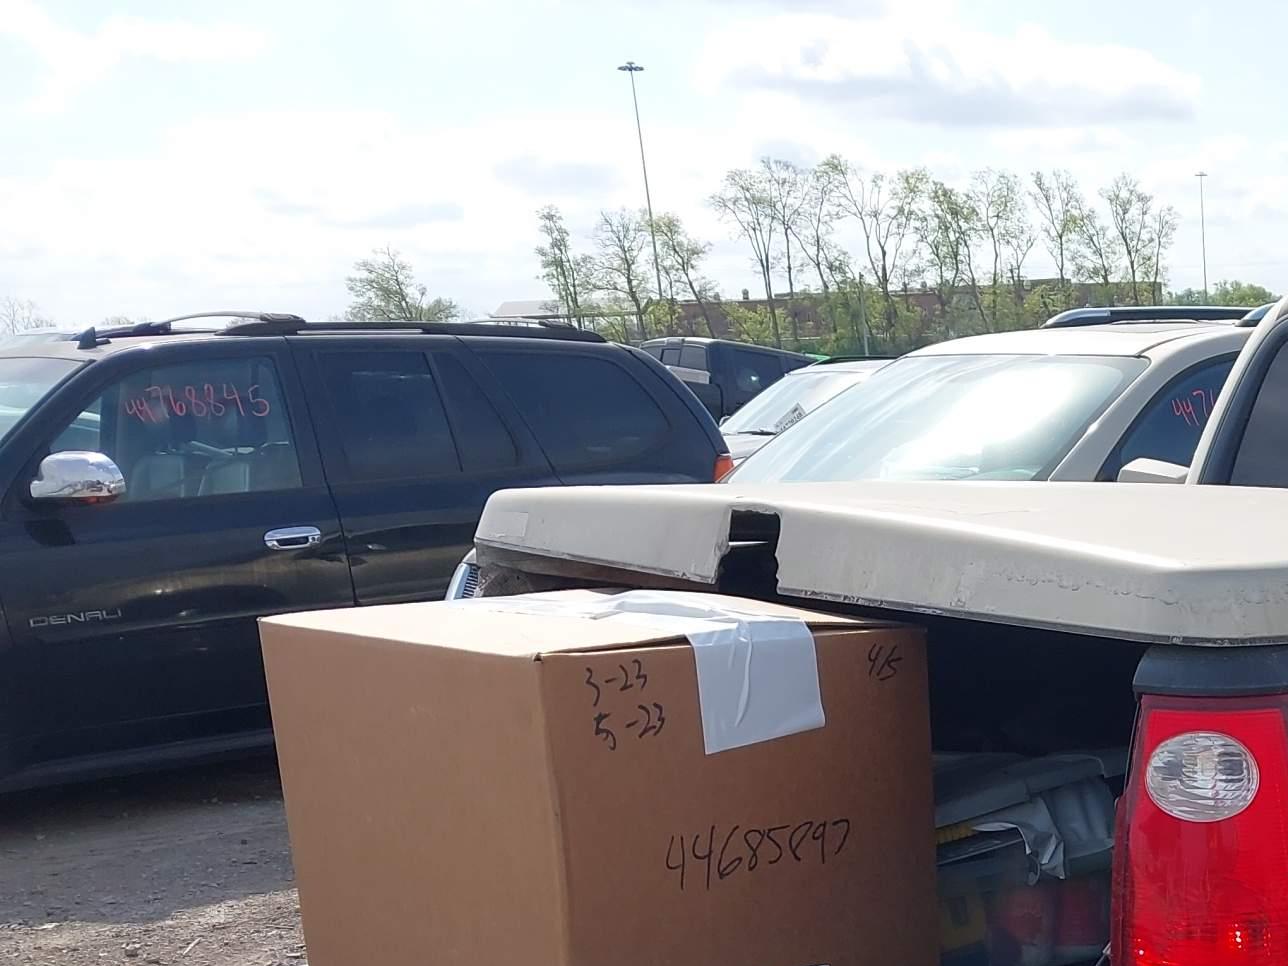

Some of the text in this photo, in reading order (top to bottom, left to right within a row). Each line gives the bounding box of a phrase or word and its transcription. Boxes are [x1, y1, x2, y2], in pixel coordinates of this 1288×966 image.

[125, 383, 270, 424] 44768845
[29, 608, 122, 628] DENALI
[586, 659, 647, 706] 3-23
[666, 818, 850, 891] 44685897
